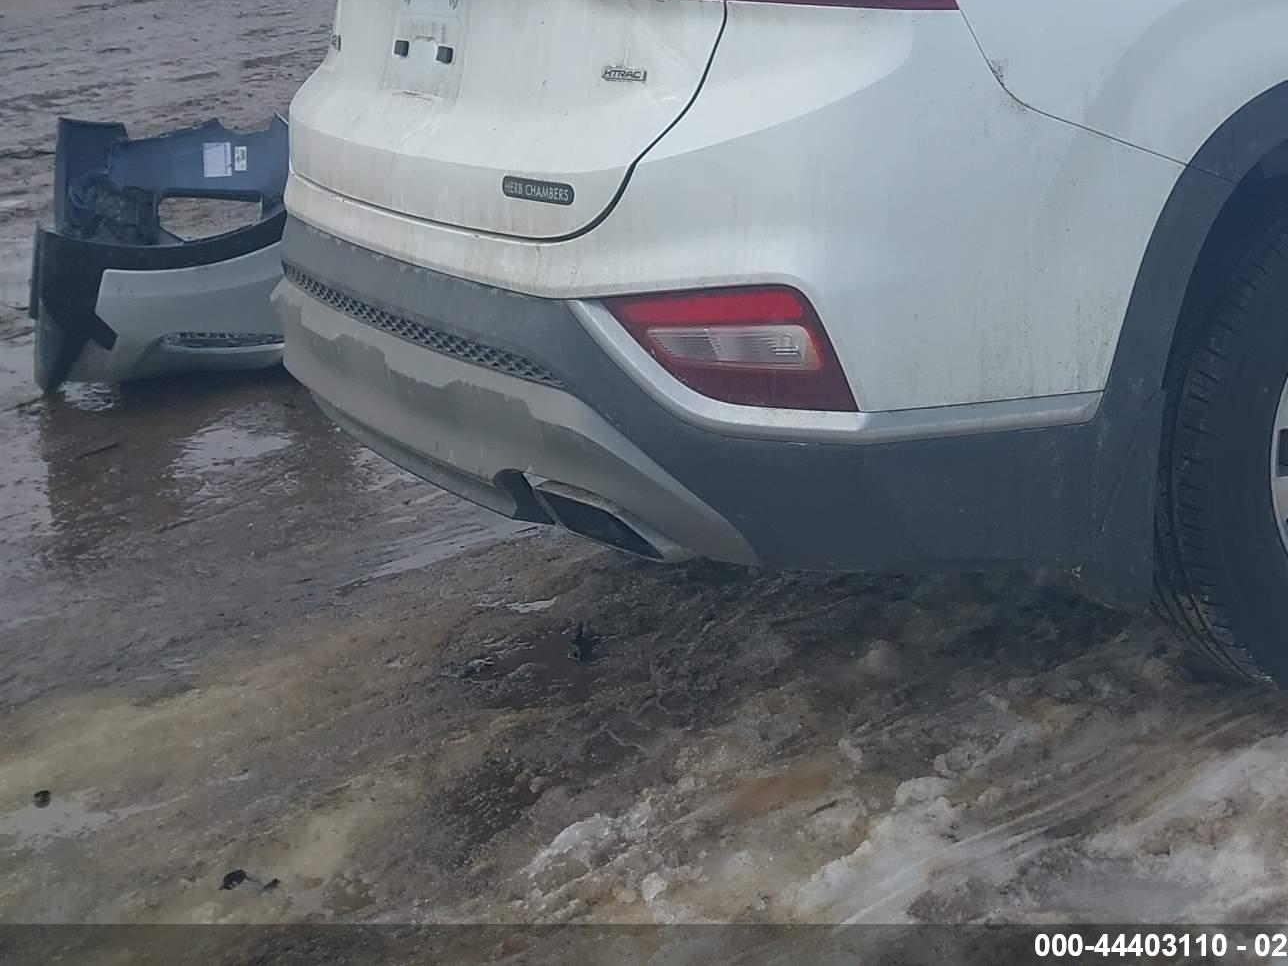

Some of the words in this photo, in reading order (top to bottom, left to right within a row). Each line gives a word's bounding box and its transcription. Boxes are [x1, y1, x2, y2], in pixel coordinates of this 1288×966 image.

[603, 68, 642, 79] HTRAC
[504, 179, 523, 195] HERB
[525, 183, 570, 202] CHAMBERS
